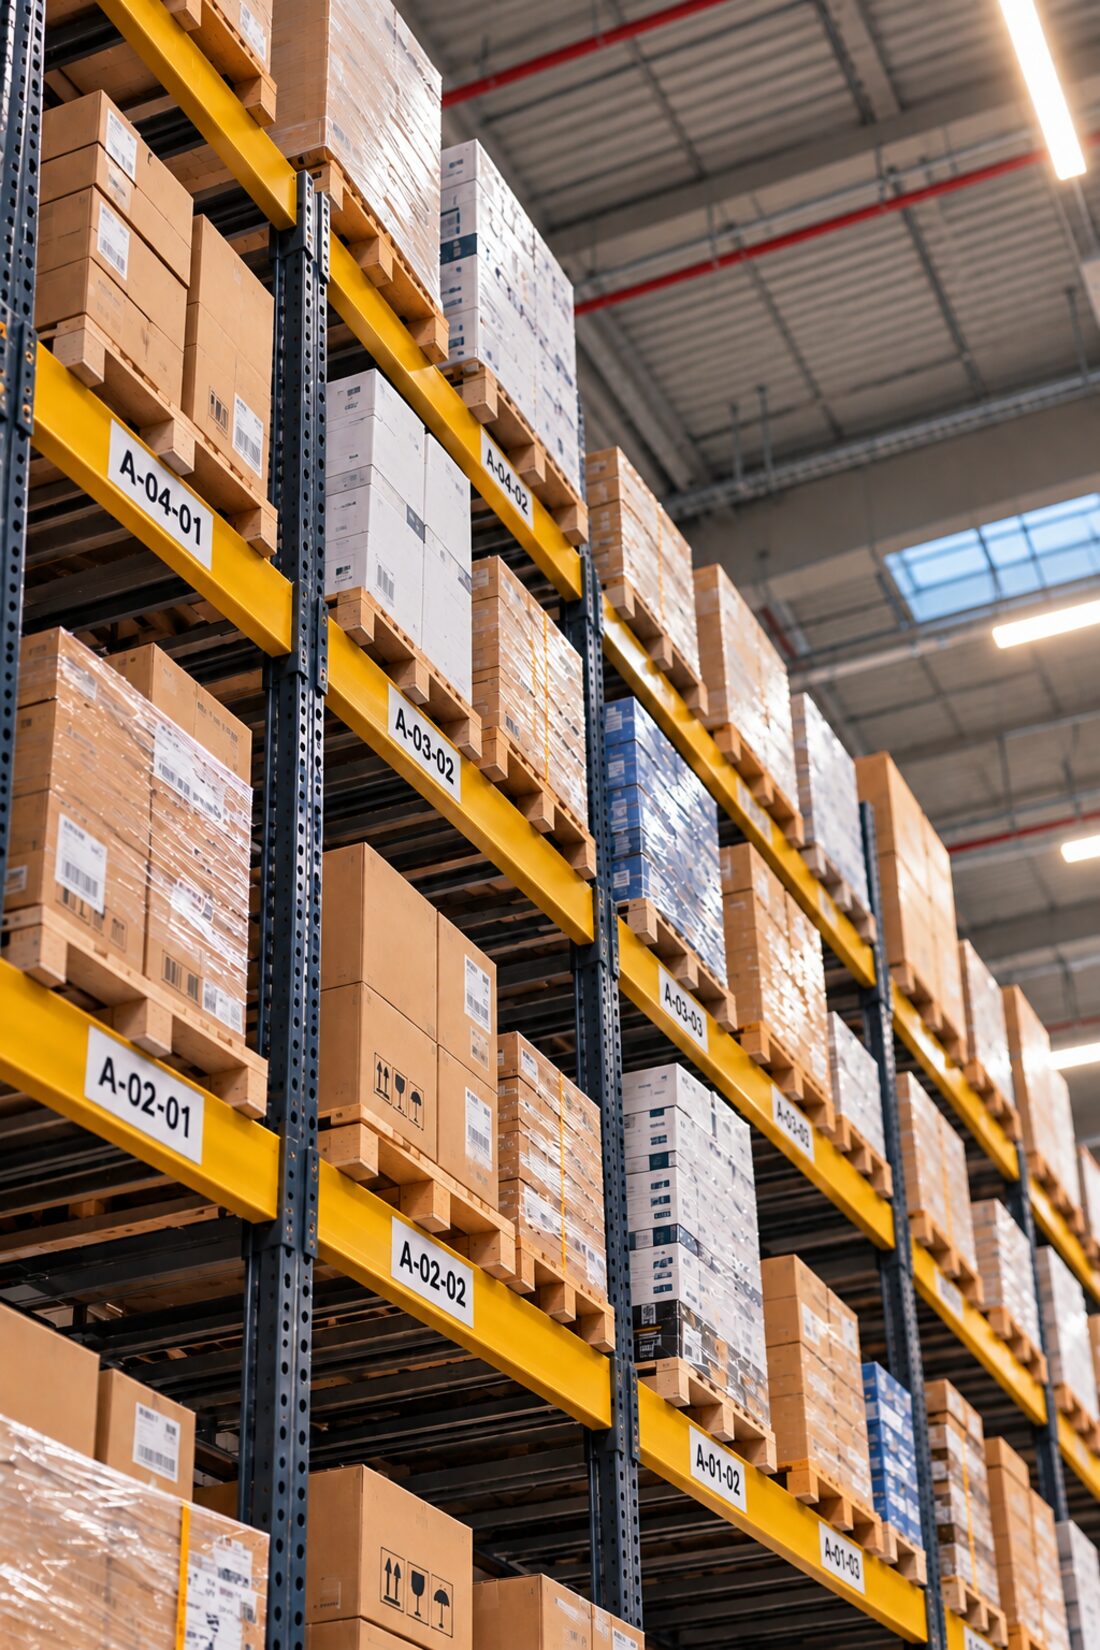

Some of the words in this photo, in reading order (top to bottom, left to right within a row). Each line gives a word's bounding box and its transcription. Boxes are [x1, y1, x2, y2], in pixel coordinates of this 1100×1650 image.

[119, 449, 202, 546] A-04-01
[486, 448, 528, 515] A-04-02
[395, 707, 454, 785] A-03-02
[664, 983, 703, 1039] A-03-03
[98, 1056, 190, 1138] A-02-01
[399, 1240, 466, 1308] A-02-02
[696, 1443, 741, 1496] A-01-02
[825, 1537, 860, 1580] A-01-03
